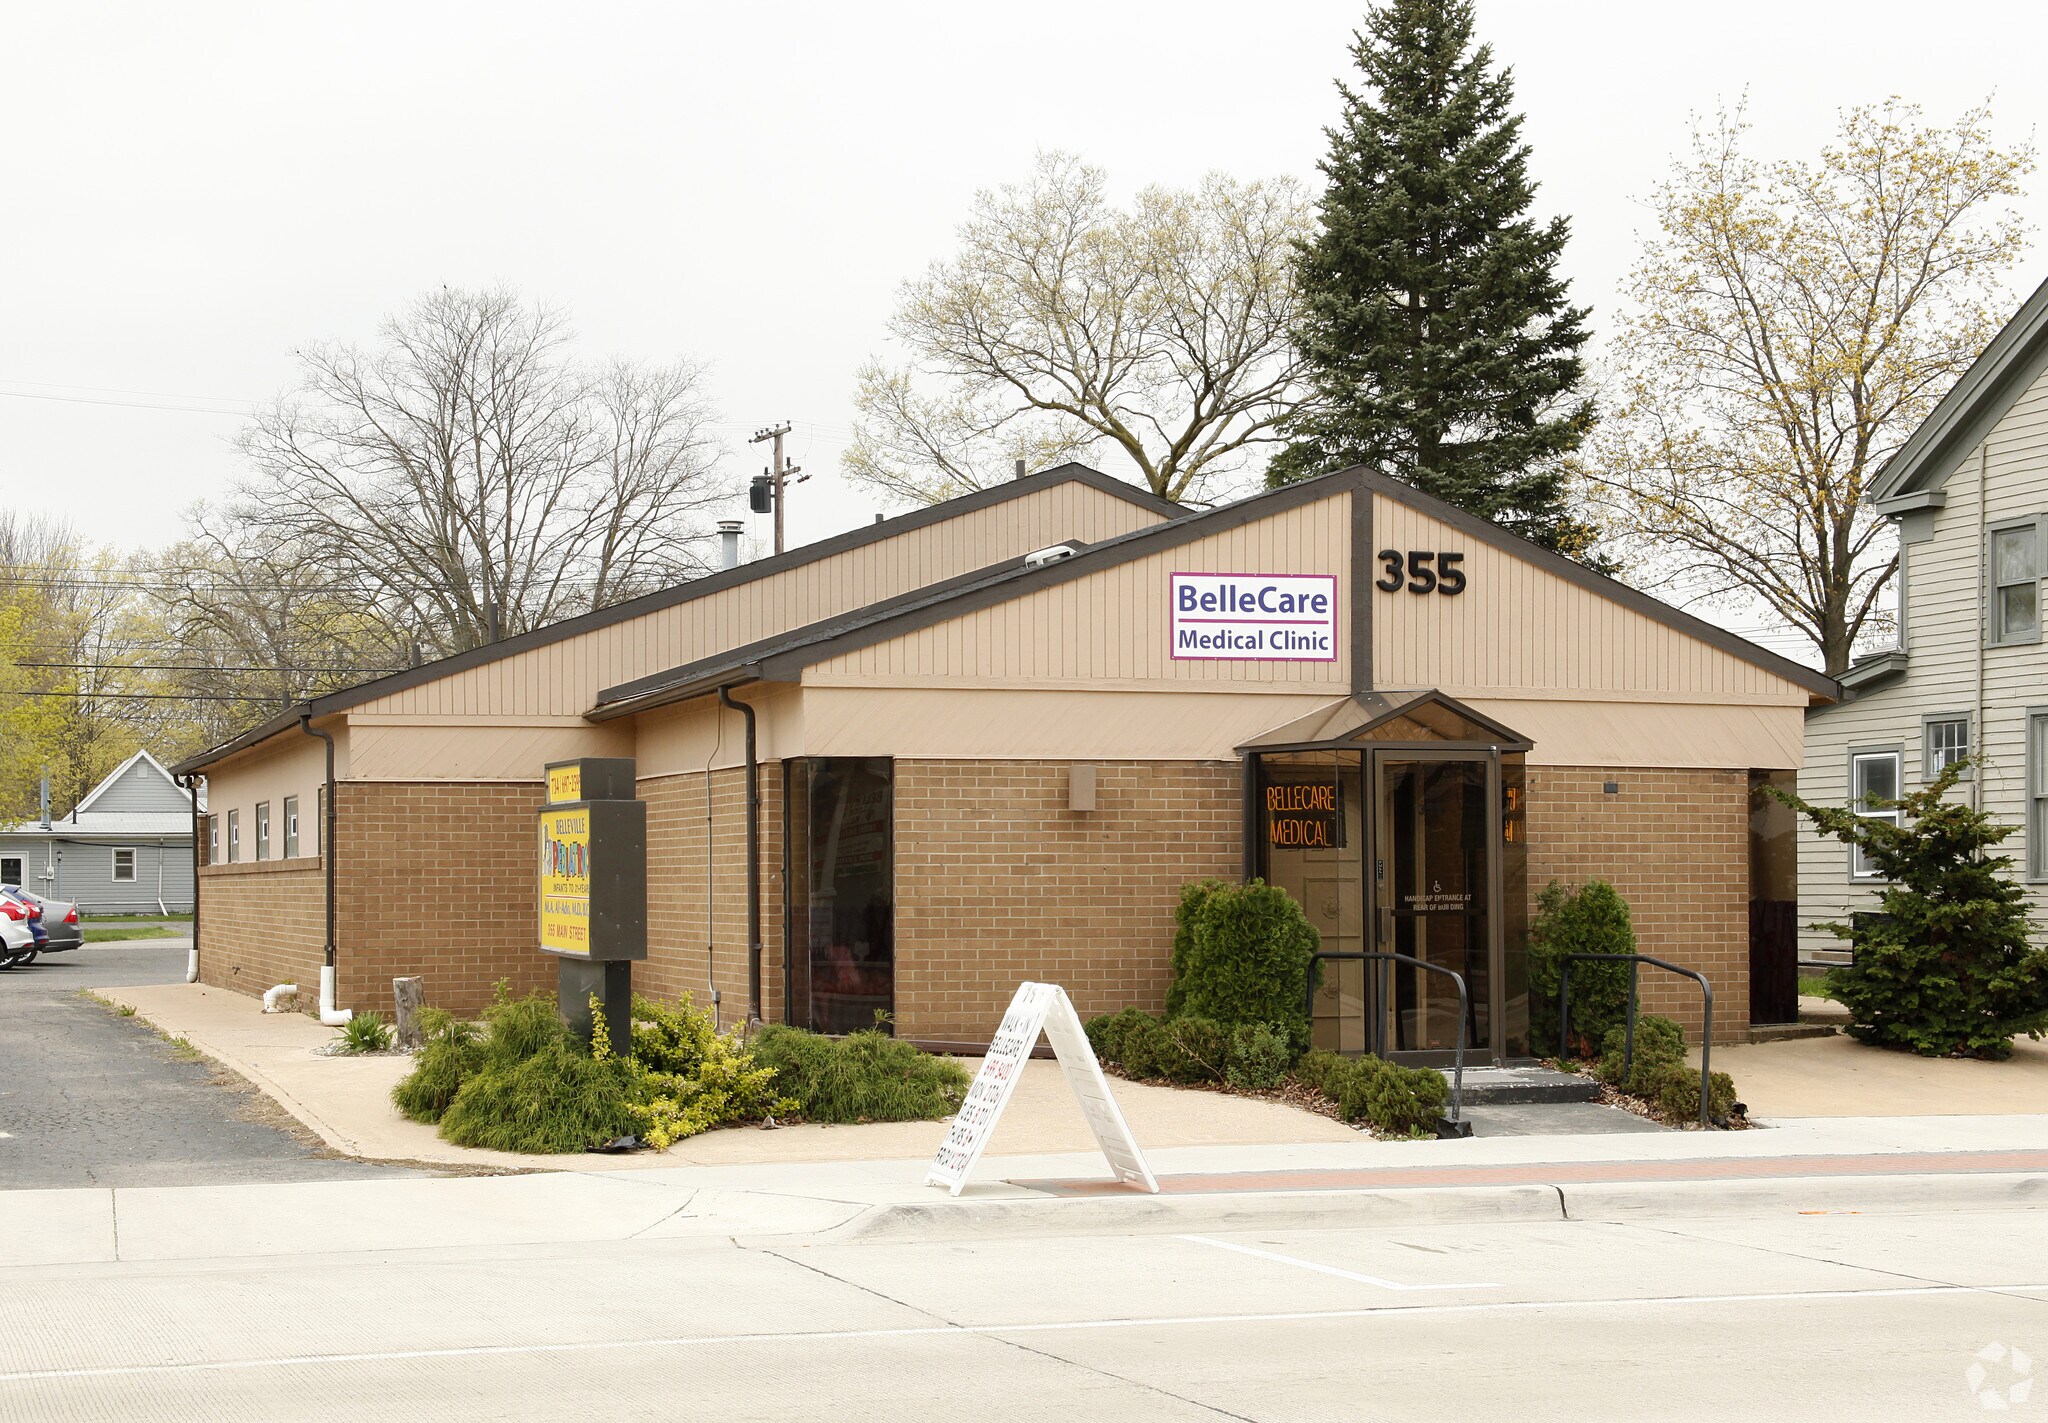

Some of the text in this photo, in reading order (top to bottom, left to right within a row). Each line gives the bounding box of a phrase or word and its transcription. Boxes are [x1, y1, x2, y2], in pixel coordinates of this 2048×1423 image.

[1376, 549, 1467, 596] 355
[1178, 584, 1328, 614] BelleCare
[1178, 629, 1329, 651] Medical Clinic
[1267, 786, 1335, 811] BELLECARE
[556, 818, 585, 834] BELLEVILLE
[1271, 819, 1332, 846] MEDICAL
[1434, 894, 1463, 902] ENTRANCE
[556, 924, 568, 939] MAIN
[569, 926, 586, 942] STREET
[988, 1034, 1024, 1058] BELLECARE
